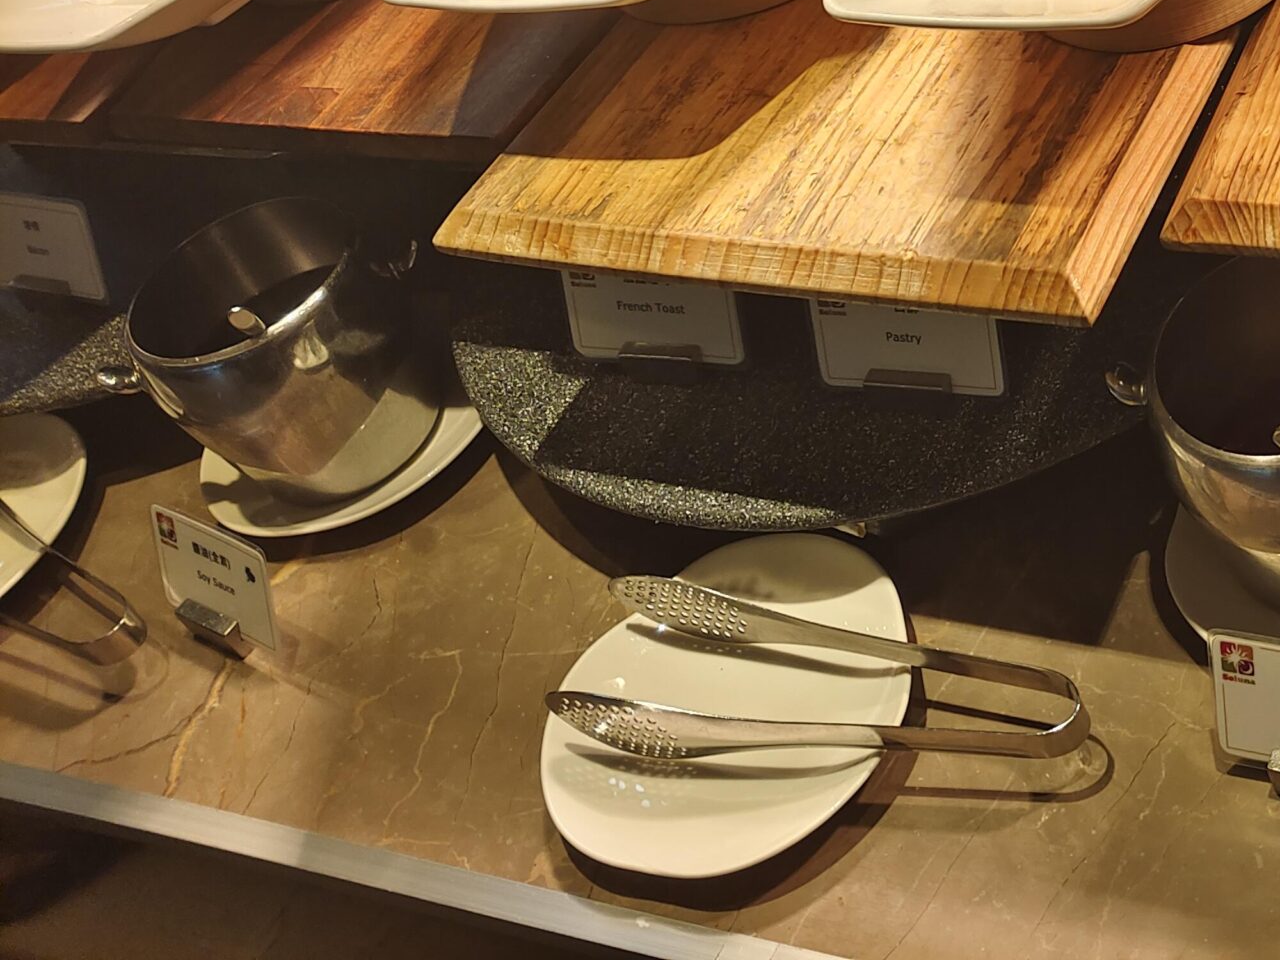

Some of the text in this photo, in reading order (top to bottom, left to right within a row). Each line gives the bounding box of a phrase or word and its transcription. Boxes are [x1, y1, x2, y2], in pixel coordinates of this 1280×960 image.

[616, 300, 686, 314] French Toast
[886, 331, 922, 345] Pastry
[196, 569, 236, 596] Soy Sauce
